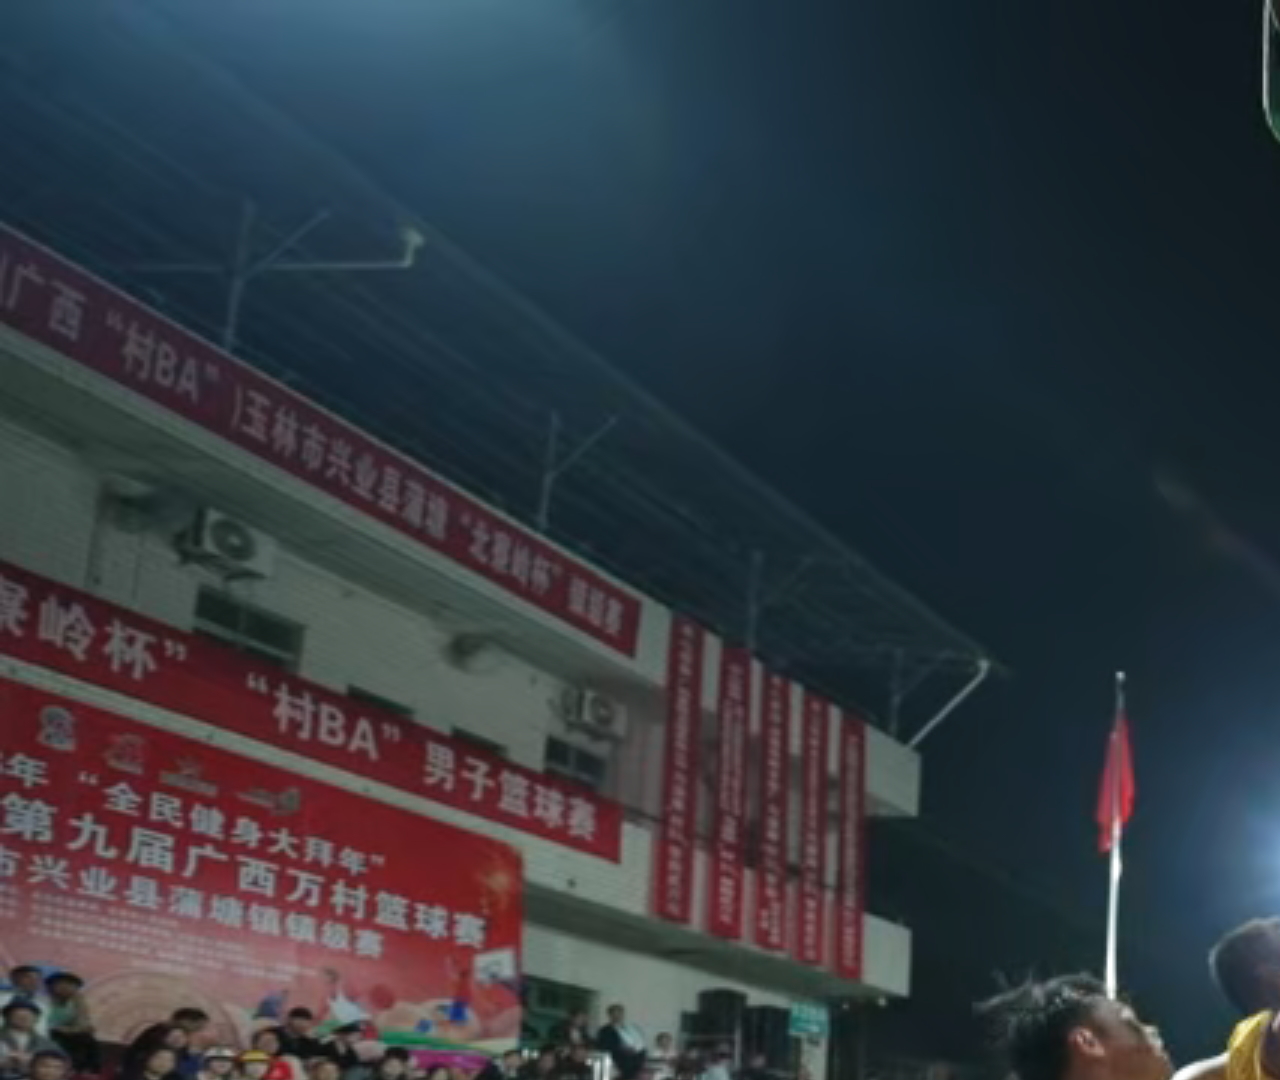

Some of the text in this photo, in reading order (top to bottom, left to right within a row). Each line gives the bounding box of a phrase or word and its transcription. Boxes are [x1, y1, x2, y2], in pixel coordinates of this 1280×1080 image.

[422, 741, 598, 843] 男子篮球赛
[0, 790, 488, 950] 第九届广西万村篮球赛
